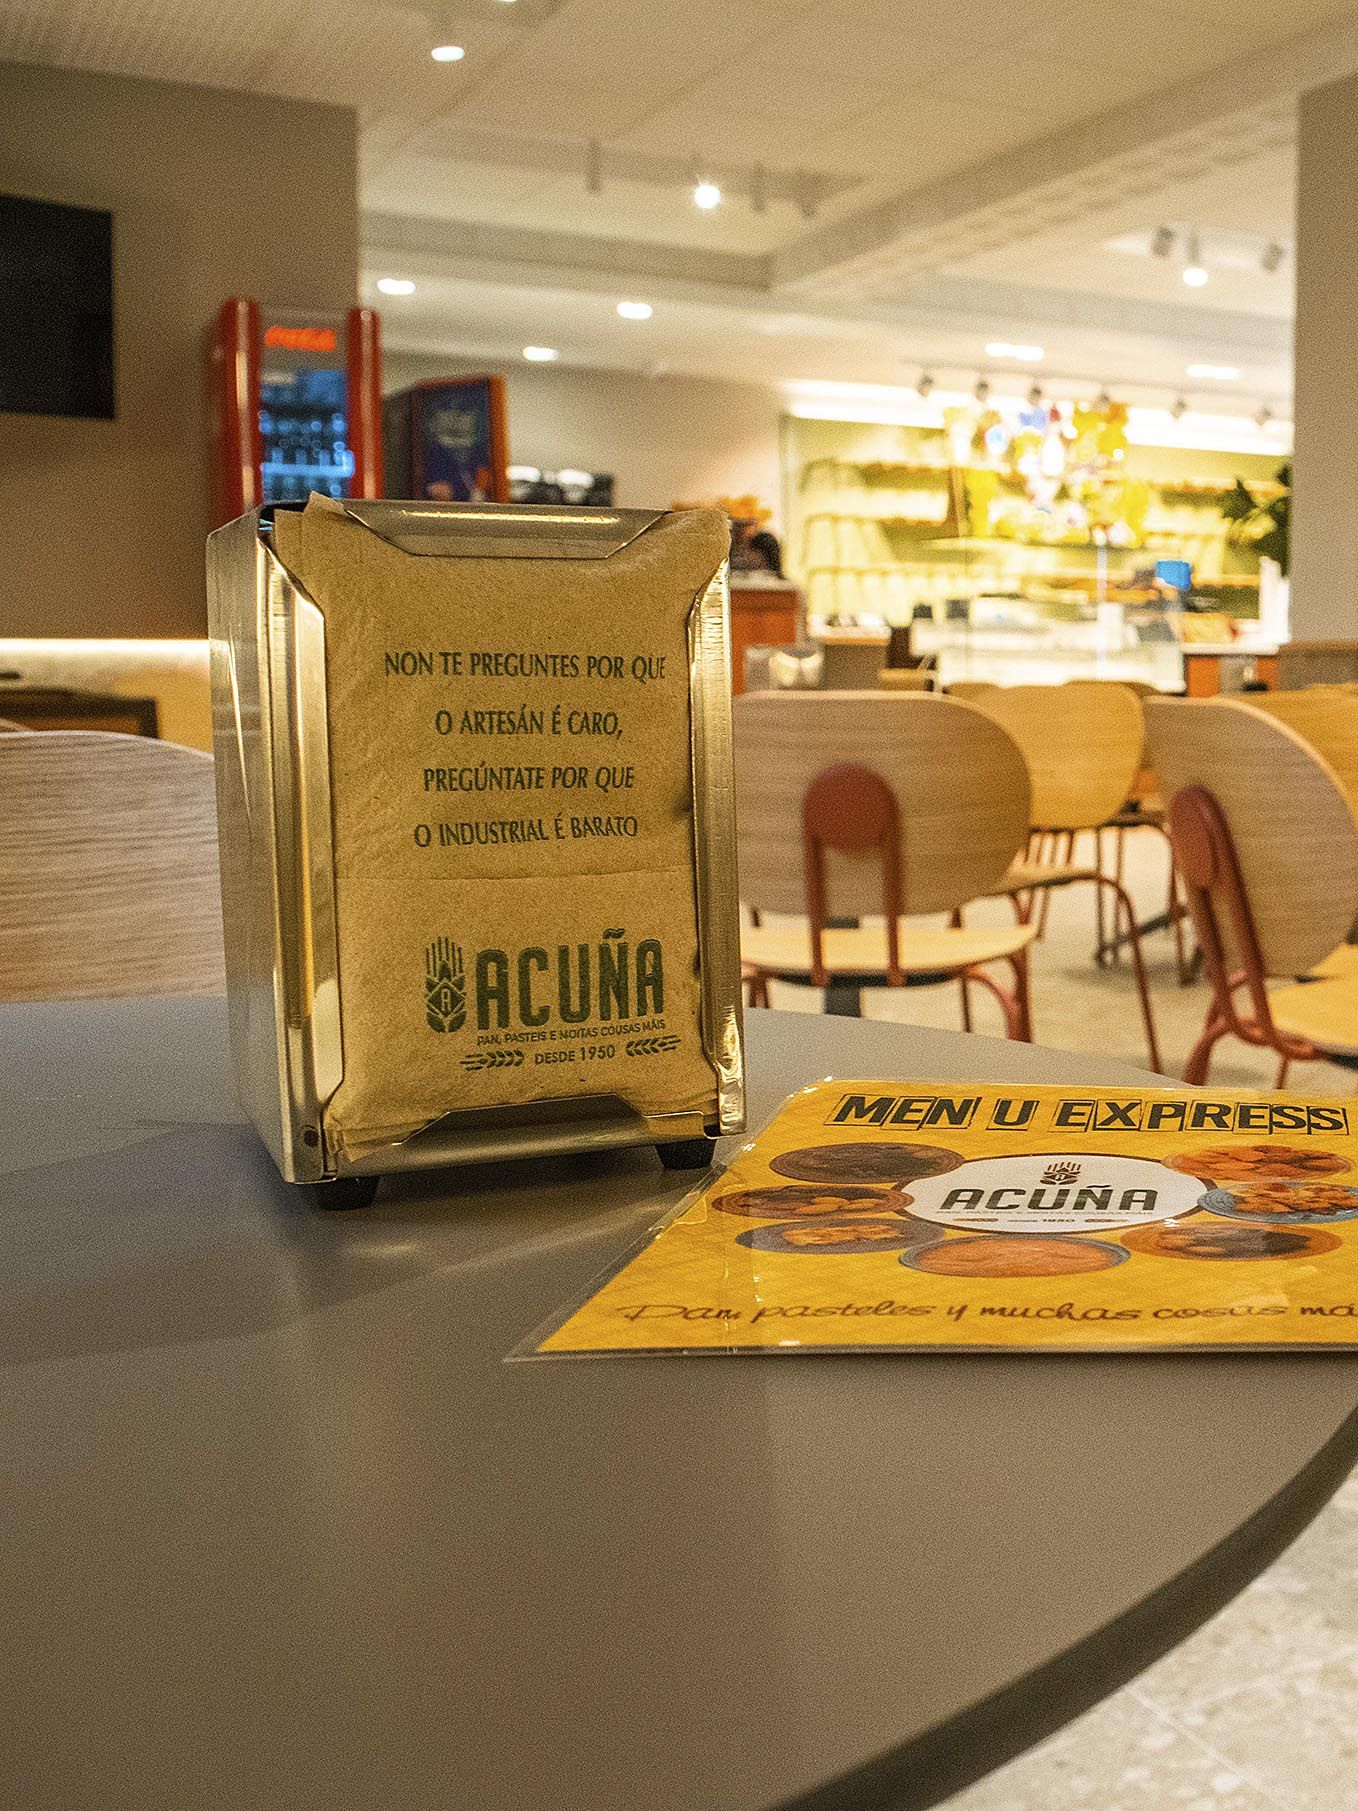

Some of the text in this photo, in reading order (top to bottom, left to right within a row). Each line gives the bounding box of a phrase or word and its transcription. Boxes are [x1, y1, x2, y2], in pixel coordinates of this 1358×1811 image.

[384, 651, 666, 683] NON TE PREGUNTES POR QUE
[435, 704, 623, 740] O ARTESÁN É CARO,
[424, 761, 634, 793] PREGÚNTATE POR QUE
[414, 814, 637, 847] O INDUSTRIAL É BARATO
[475, 927, 664, 1030] ACUÑA
[504, 1030, 547, 1043] PASTEIS
[550, 1030, 557, 1040] E
[560, 1028, 598, 1040] MOITAS
[600, 1023, 641, 1036] COUSAS
[534, 1044, 615, 1065] DESDE 1950
[1055, 1101, 1346, 1132] EXPRESS
[939, 1185, 1159, 1211] ACUÑA
[750, 1300, 936, 1324] pasteles
[946, 1304, 968, 1321] y
[979, 1303, 1142, 1322] muchas
[1152, 1303, 1287, 1320] cosas
